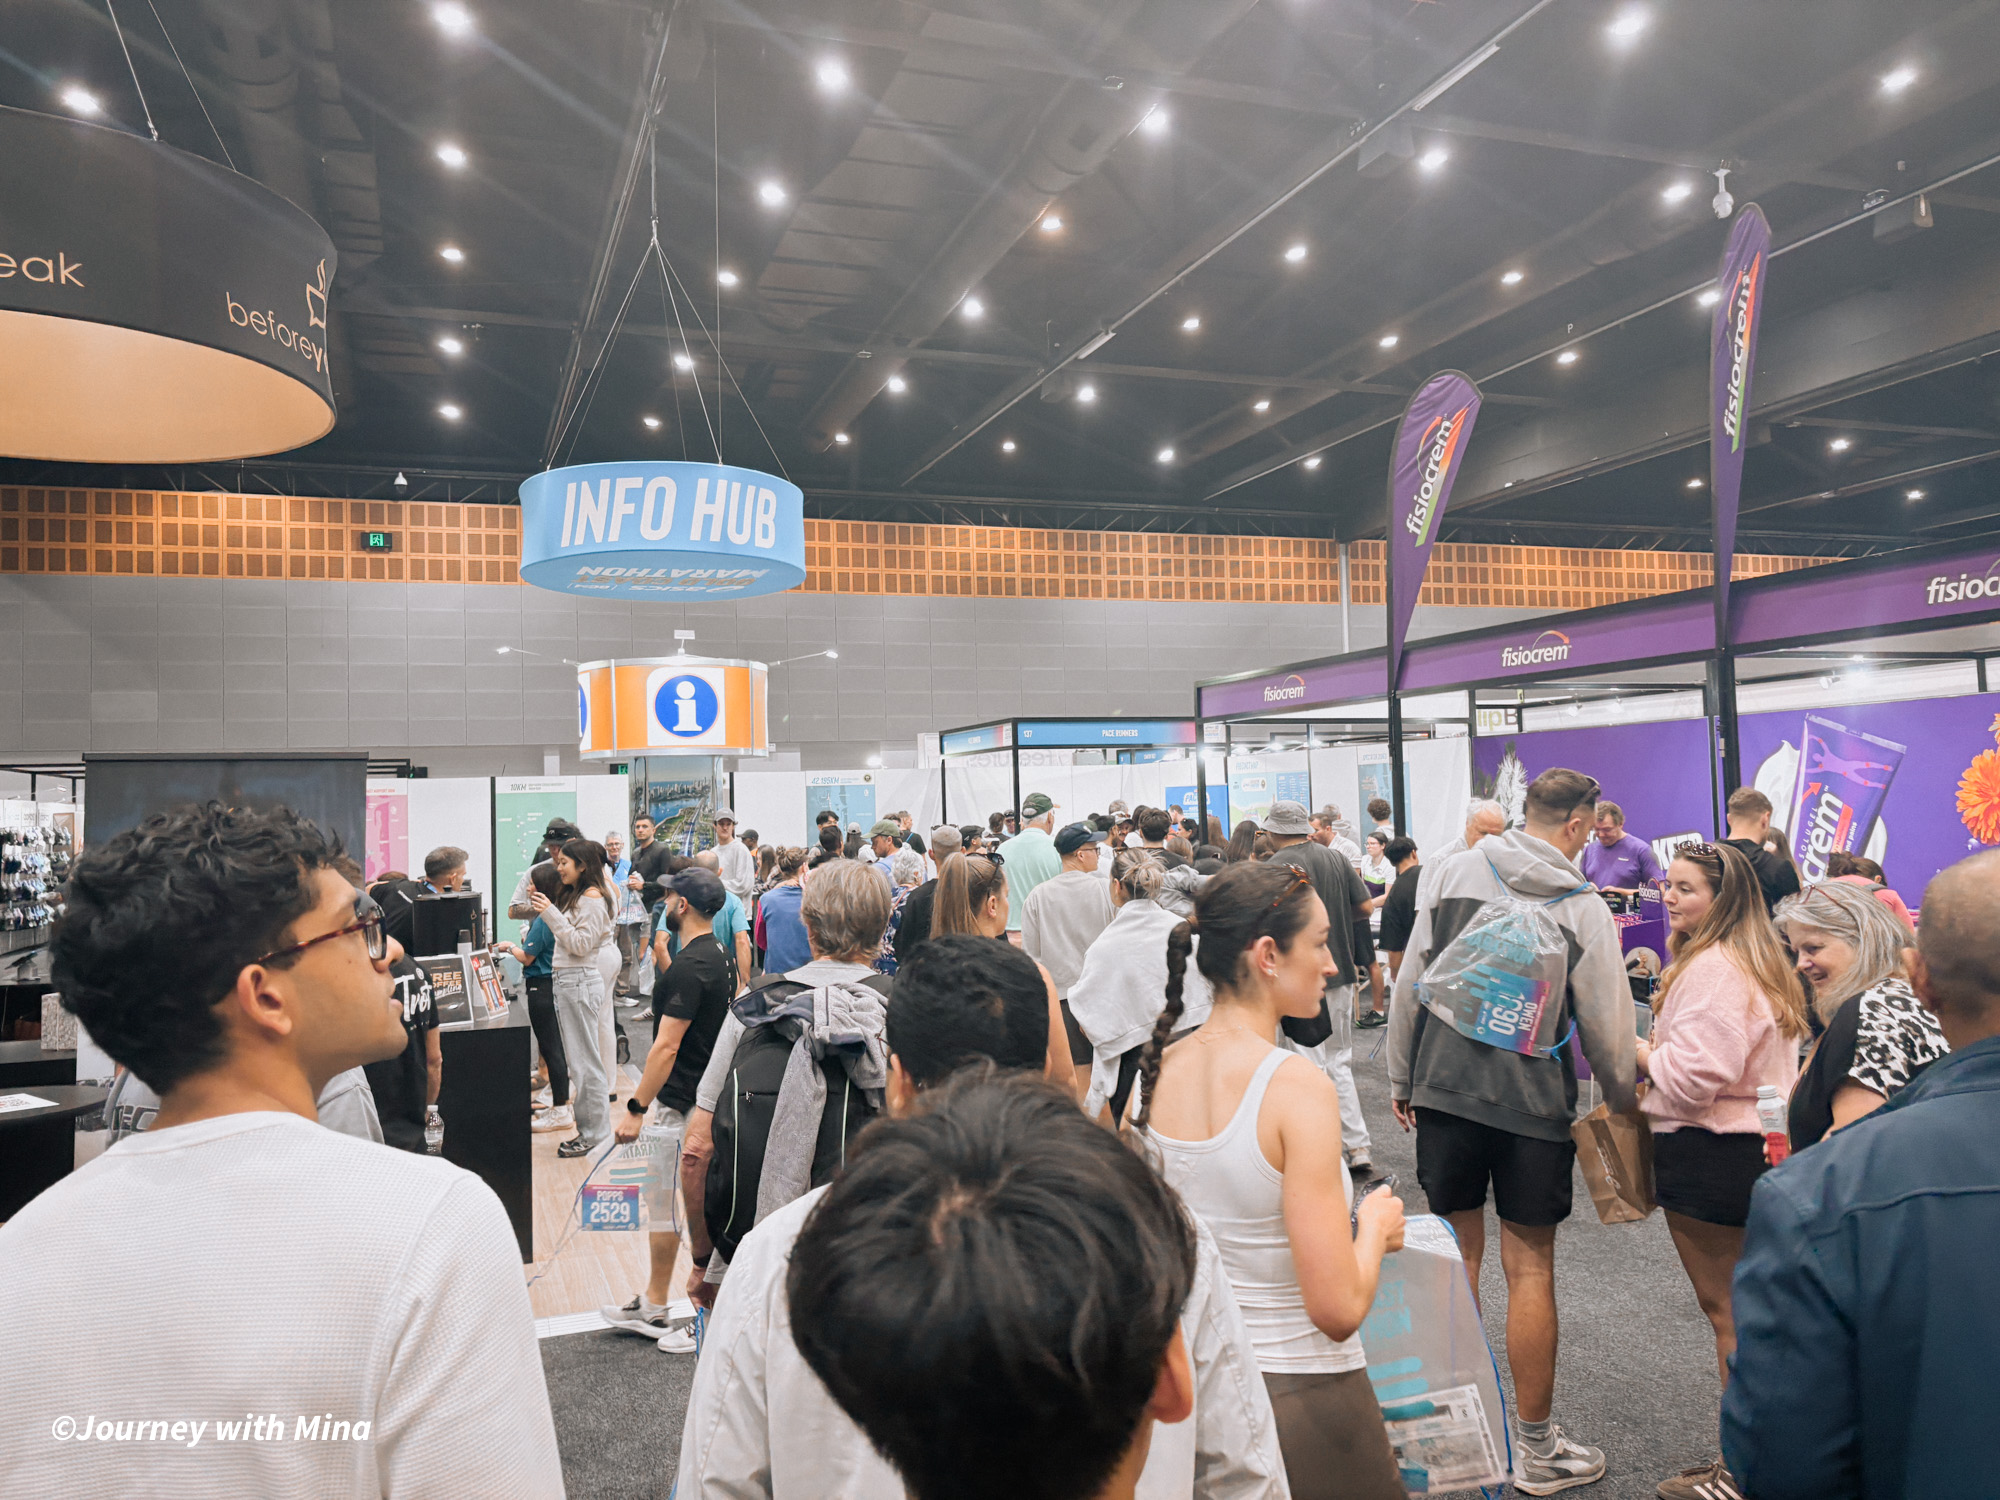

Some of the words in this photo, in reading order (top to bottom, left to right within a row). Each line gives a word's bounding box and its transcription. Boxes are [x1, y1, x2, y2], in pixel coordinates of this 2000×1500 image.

[225, 291, 328, 374] beforey
[1723, 271, 1752, 438] fisiocrem
[1406, 419, 1454, 536] fisiocrem
[560, 476, 677, 548] INFO
[690, 478, 777, 549] HUB
[576, 566, 771, 578] MARATHON
[1926, 573, 2000, 604] fisioc
[1502, 643, 1569, 668] fisiocrem
[1263, 685, 1304, 702] fisiocrem
[1101, 729, 1115, 737] PACE
[510, 783, 527, 791] 10KM
[1798, 807, 1818, 859] SOLUGEL
[1802, 792, 1844, 887] crem
[1517, 1001, 1538, 1032] OWEN
[596, 1190, 624, 1202] POPPS
[590, 1202, 631, 1223] 2529
